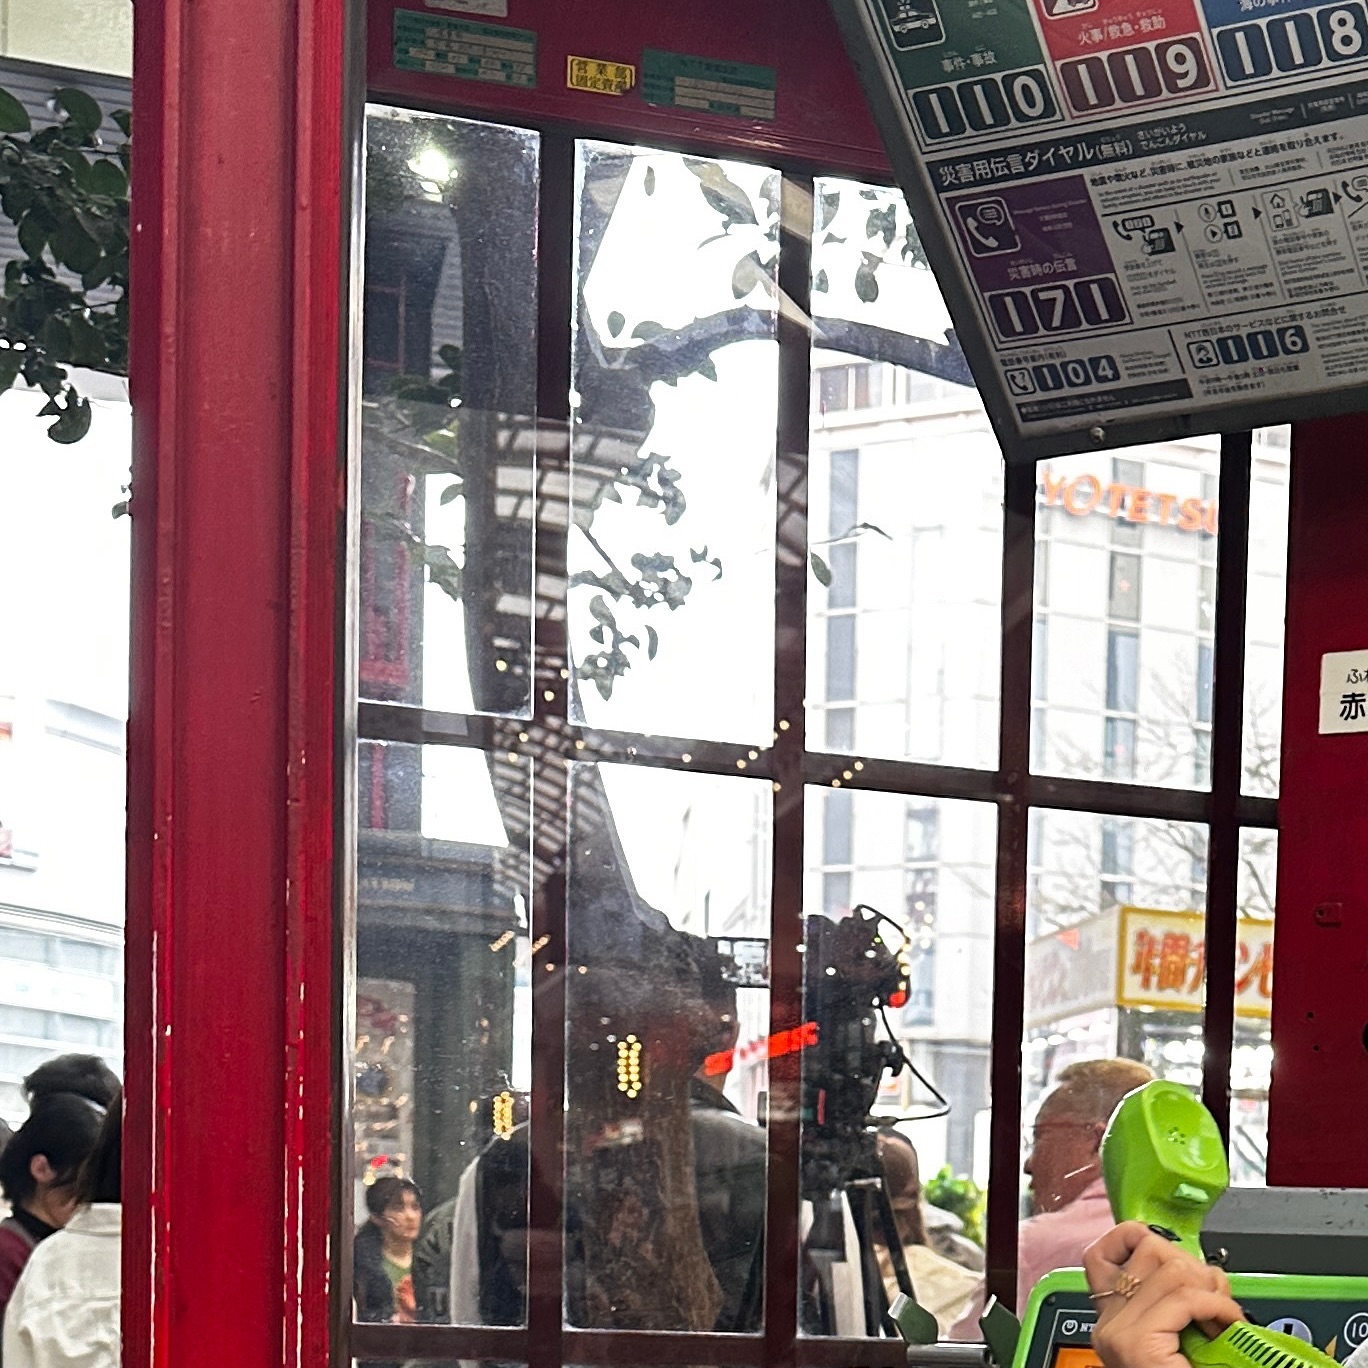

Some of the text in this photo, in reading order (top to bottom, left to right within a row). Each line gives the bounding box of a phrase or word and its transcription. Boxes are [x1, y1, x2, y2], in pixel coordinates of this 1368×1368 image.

[1234, 9, 1363, 75] 118
[1077, 43, 1199, 106] 119
[928, 74, 1045, 134] 110
[939, 139, 1134, 187] 災害用伝言ダイヤル(無料)
[1003, 282, 1110, 333] 171
[1228, 328, 1302, 363] 116
[1042, 357, 1114, 388] 104
